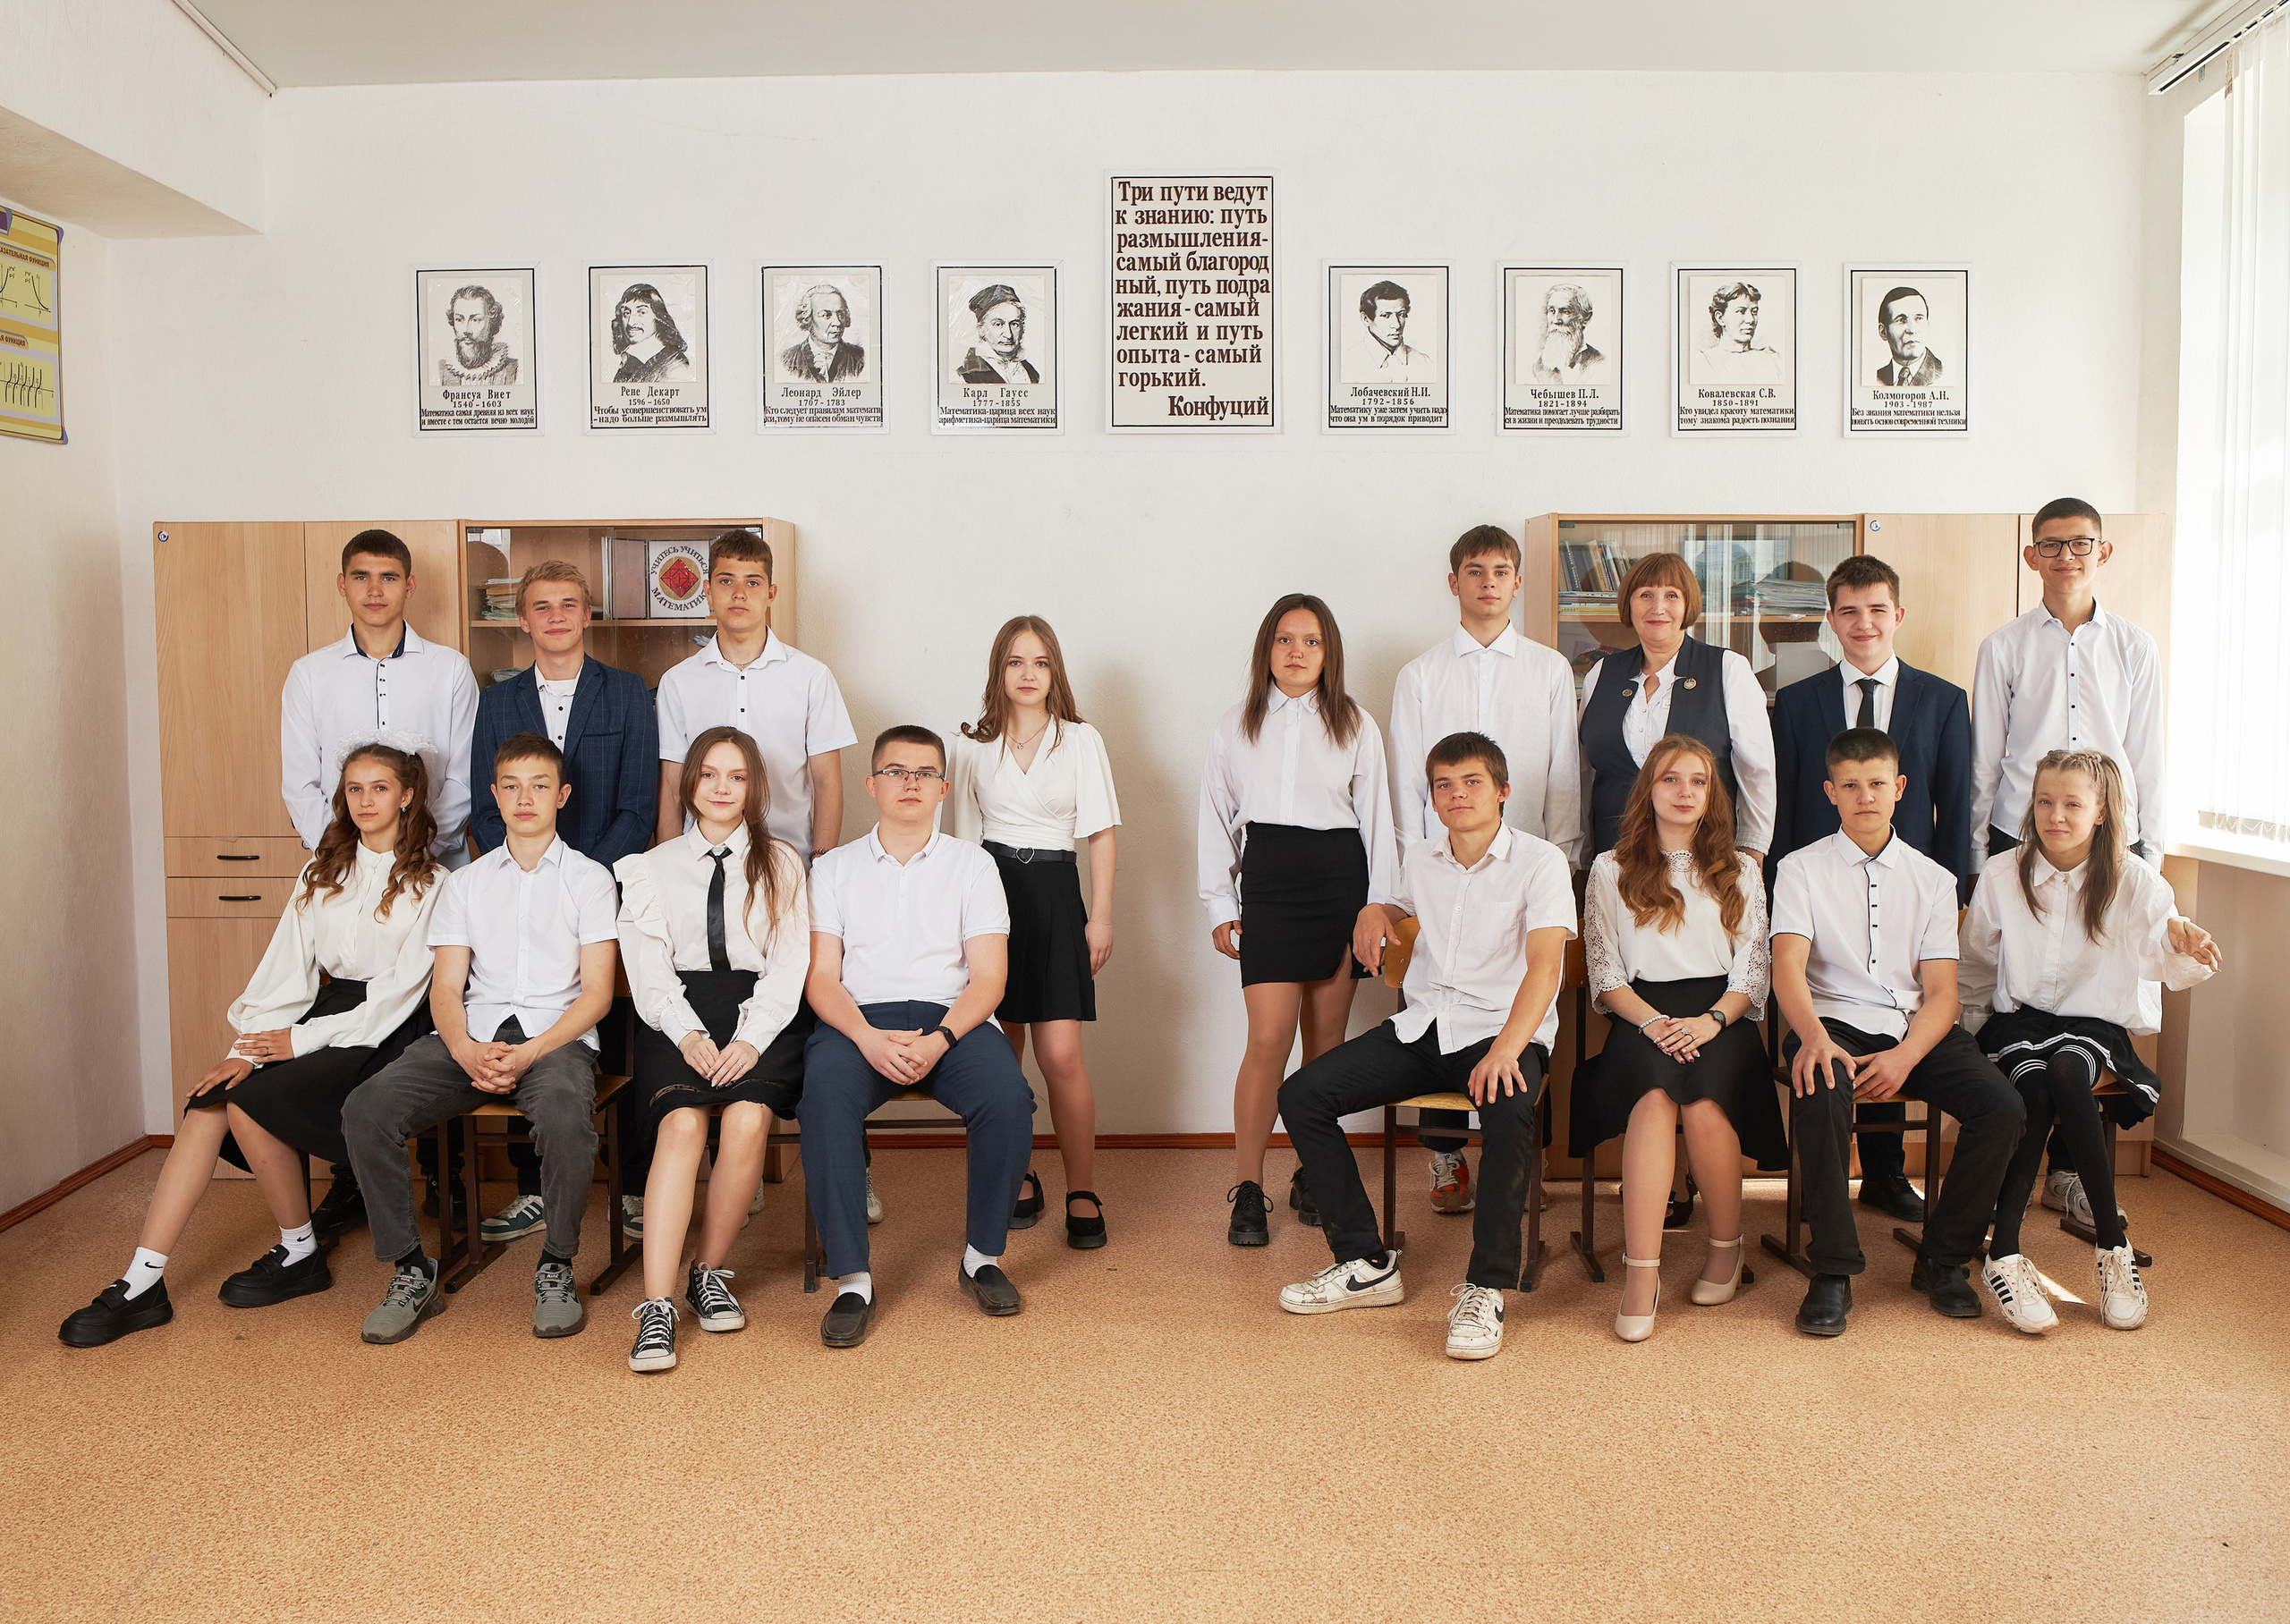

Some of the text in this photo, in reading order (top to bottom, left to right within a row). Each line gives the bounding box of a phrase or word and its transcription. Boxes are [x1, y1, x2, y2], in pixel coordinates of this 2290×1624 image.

[1118, 182, 1268, 206] Три пути ведут
[1115, 209, 1267, 229] к знанию: путь
[30, 256, 49, 267] ФУНКЦИЯ
[1117, 251, 1269, 275] самый благород
[1115, 275, 1270, 299] ный, путь подра
[1117, 301, 1182, 317] жания
[1195, 298, 1260, 317] самый
[1117, 322, 1263, 344] легкий и путь
[5, 336, 25, 347] ФУНКЦИЯ
[1117, 348, 1180, 363] опыта
[1195, 344, 1261, 363] самый
[1119, 368, 1206, 392] горький.
[443, 390, 511, 402] Франсуа Виет
[621, 386, 679, 398] Рене Декарт
[782, 387, 861, 399] Леонард Эйлер
[963, 387, 1028, 400] Карл Гаусс
[1351, 387, 1430, 397] Лобачевский Н.И.
[1531, 389, 1599, 399] Чебышев П.Л.
[1699, 388, 1776, 398] Ковалевская С.В.
[1873, 390, 1949, 402] Колмогоров А.Н.
[421, 409, 454, 417] Математика
[594, 406, 706, 415] Чтобы усовершенствовать ум
[765, 406, 778, 414] Кто
[780, 408, 808, 416] следует
[1168, 395, 1268, 420] Конфуций
[1330, 405, 1372, 415] Математику
[1374, 407, 1387, 415] уже
[1410, 407, 1430, 415] учить
[1505, 407, 1540, 415] Математика
[1570, 409, 1589, 417] лучше
[1590, 407, 1620, 417] разбирать
[1694, 408, 1718, 417] увидел
[1720, 409, 1747, 417] красоту
[1853, 408, 1864, 416] Без
[510, 416, 534, 424] молодой
[623, 414, 653, 422] больше
[656, 414, 706, 424] размышлять
[832, 414, 854, 422] обман
[1359, 416, 1368, 424] ум
[1378, 416, 1405, 424] порядок
[1408, 416, 1443, 424] приводит
[1545, 418, 1584, 426] преодолевать
[1586, 418, 1618, 427] трудности
[1680, 418, 1697, 426] тому
[1732, 418, 1760, 426] радость
[1894, 418, 1936, 427] современной
[651, 546, 708, 575] УЧИТЕСЬ УЧИТЬСЯ
[651, 588, 706, 611] МАТЕМАТИК
